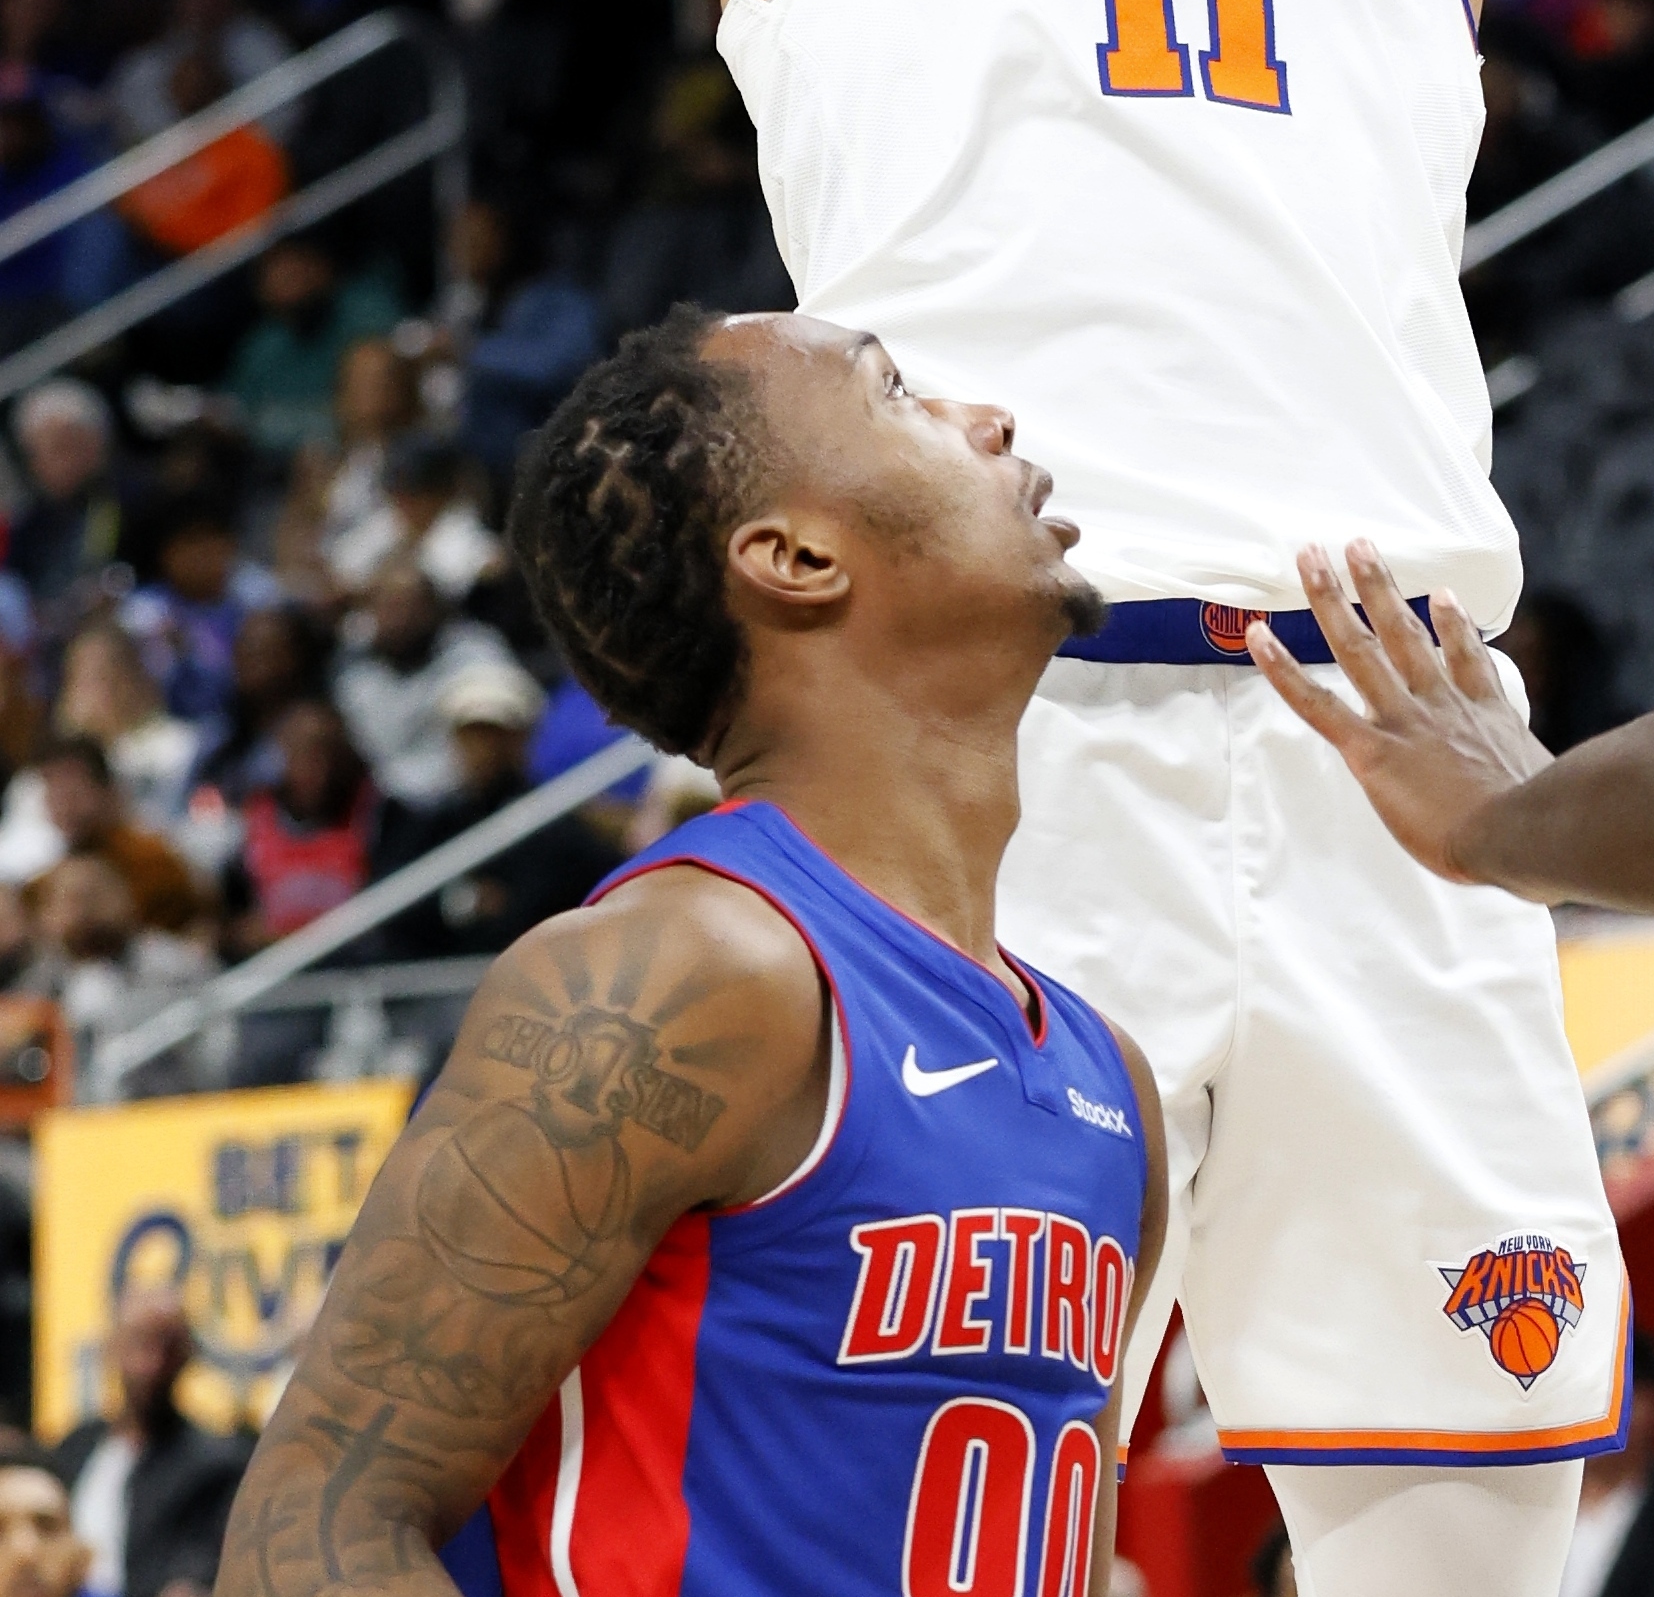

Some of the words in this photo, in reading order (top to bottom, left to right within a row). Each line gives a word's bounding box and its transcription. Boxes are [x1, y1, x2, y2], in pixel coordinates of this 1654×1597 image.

[1066, 1088, 1133, 1137] StockX
[1498, 1236, 1523, 1254] NEW
[1526, 1234, 1553, 1252] YORK
[837, 1206, 1135, 1387] DETRO
[1443, 1247, 1585, 1320] KNICKS
